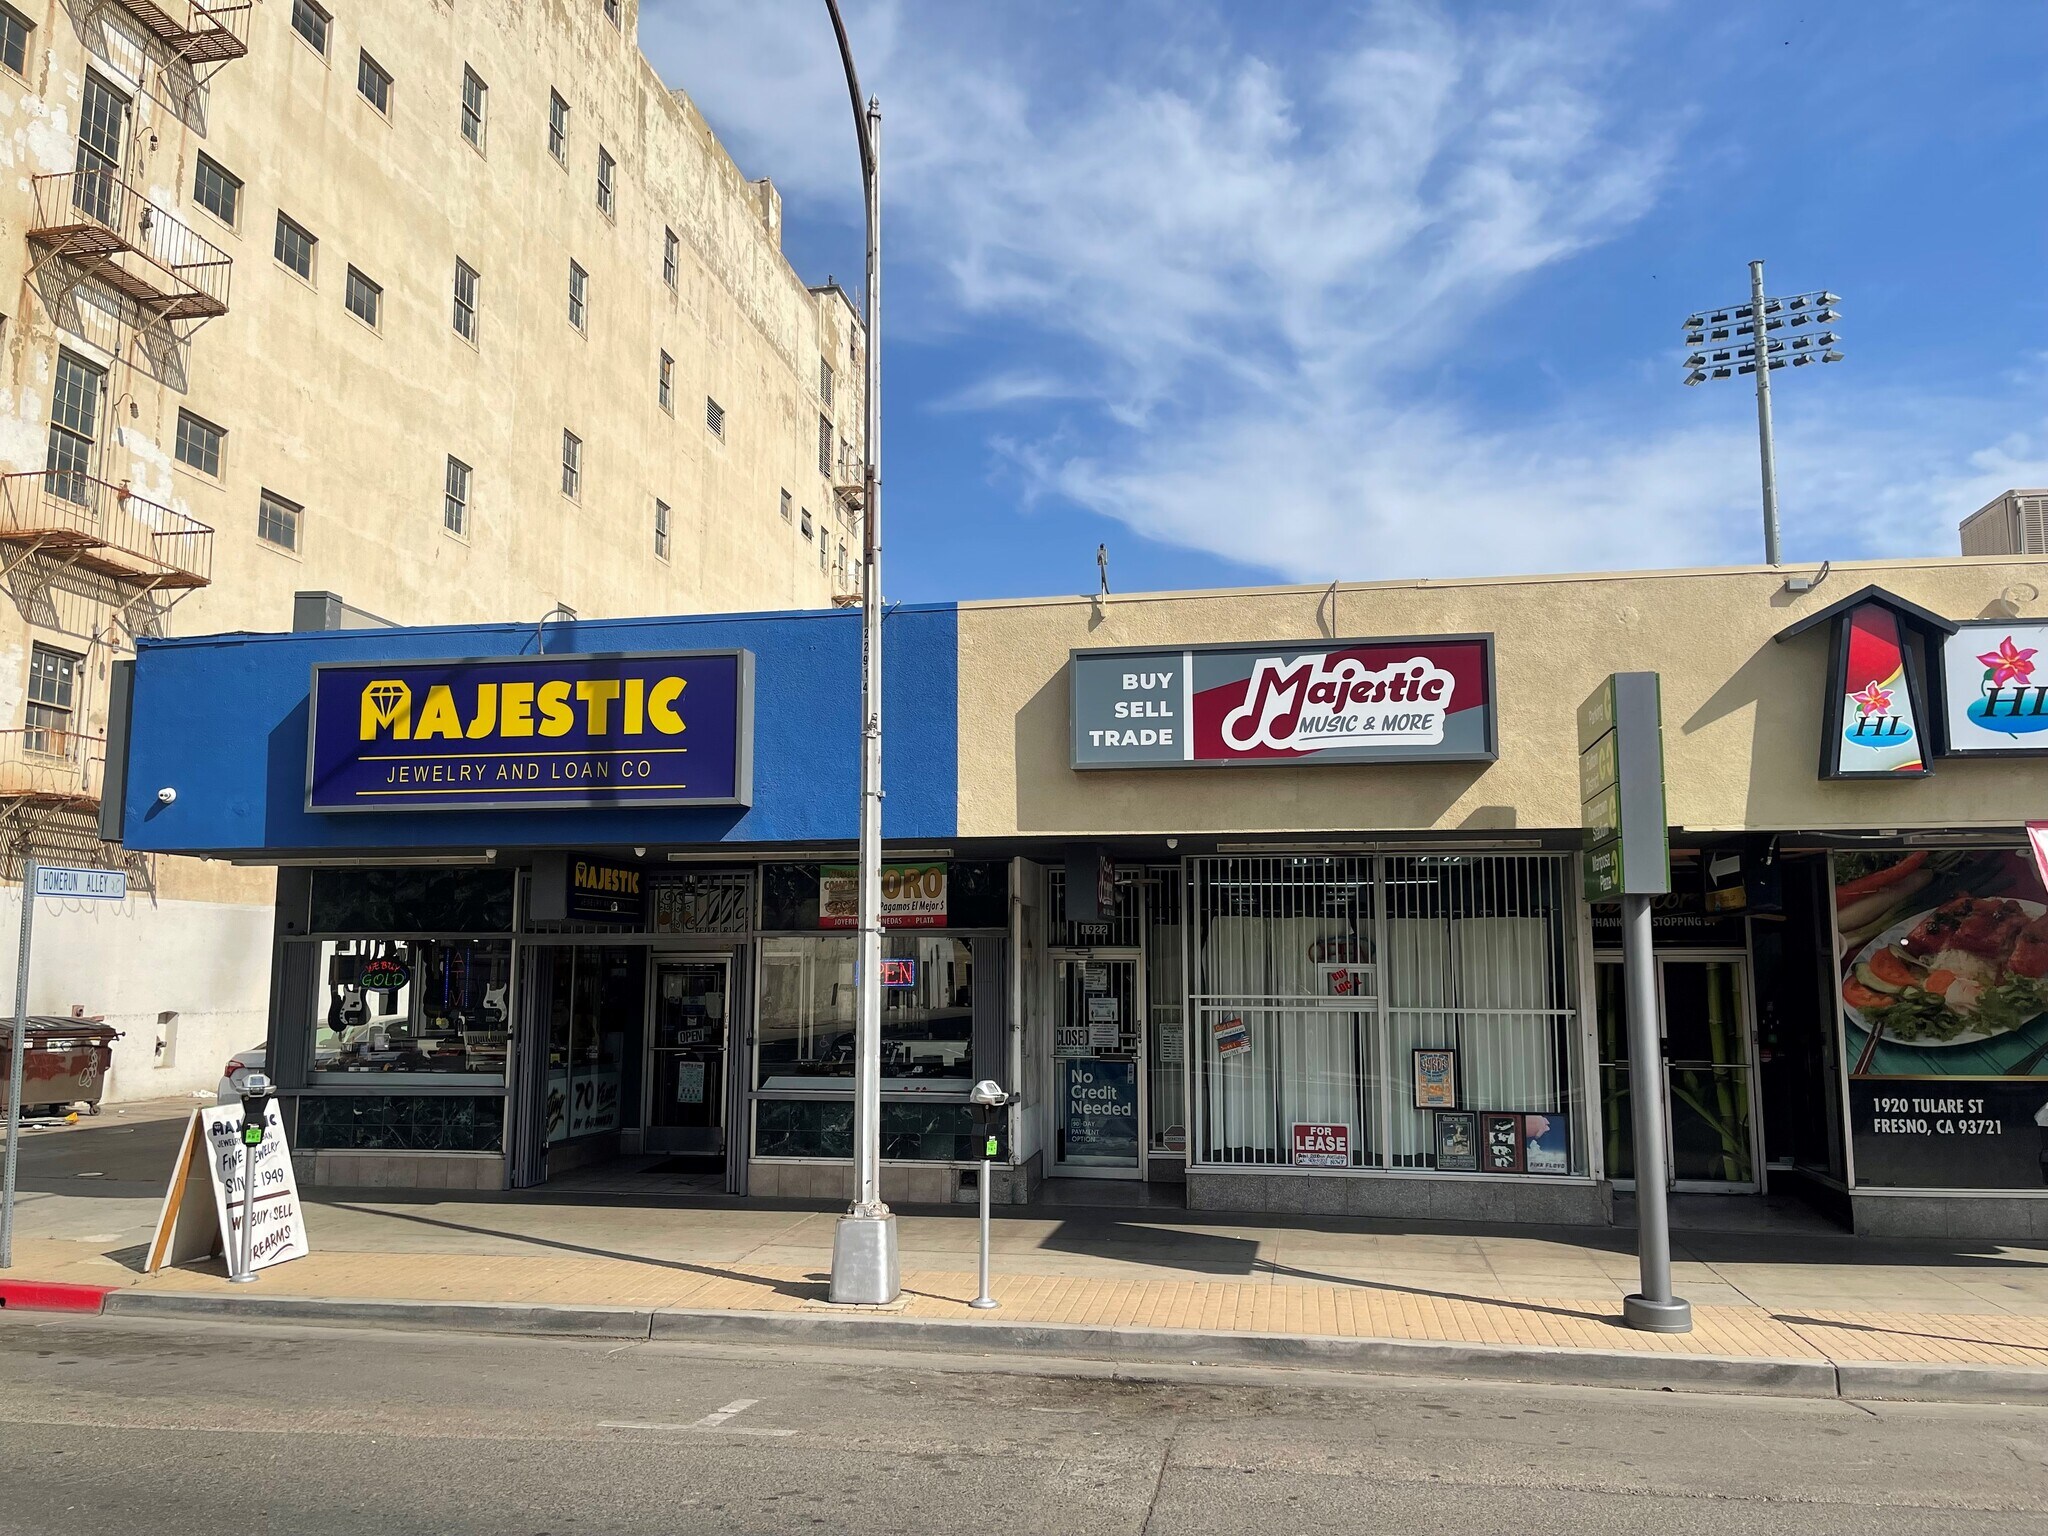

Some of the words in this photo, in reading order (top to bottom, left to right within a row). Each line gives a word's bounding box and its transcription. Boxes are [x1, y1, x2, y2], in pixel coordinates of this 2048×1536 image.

[1122, 672, 1173, 690] BUY
[359, 676, 688, 741] MAJESTIC
[1114, 701, 1173, 719] SELL
[1231, 663, 1443, 742] Majestic
[1299, 715, 1358, 733] MUSIC
[1362, 716, 1375, 731] &
[1381, 713, 1435, 731] MORE
[1853, 715, 1910, 737] HL
[1089, 729, 1173, 747] TRADE
[386, 764, 487, 783] JEWELRY
[496, 763, 540, 781] AND
[552, 761, 609, 780] LOAN
[621, 759, 652, 778] CO
[43, 871, 78, 891] HOMERUN
[87, 874, 108, 893] ALLEY
[575, 861, 640, 894] MAJESTIC
[881, 867, 943, 899] ORO
[911, 901, 919, 911] El
[919, 901, 938, 912] Mejor
[915, 916, 935, 924] PLATA
[1653, 917, 1701, 927] STOPPING
[1083, 925, 1107, 934] 1922
[362, 973, 405, 987] GOLD
[1331, 968, 1348, 981] BUY
[680, 1030, 702, 1043] OPEN
[1071, 1069, 1094, 1083] No
[575, 1080, 594, 1112] 70
[1071, 1084, 1117, 1100] Credit
[1071, 1100, 1131, 1116] Needed
[1873, 1097, 1908, 1113] 1920
[1912, 1098, 1964, 1114] TULARE
[1968, 1099, 1984, 1114] ST
[1310, 1126, 1332, 1136] FOR
[1873, 1119, 1932, 1136] FRESNO,
[1935, 1119, 1955, 1134] CA
[1958, 1119, 2002, 1135] 93721
[1296, 1135, 1346, 1152] LEASE
[222, 1150, 243, 1172] FINE
[255, 1141, 281, 1164] EWELRY
[261, 1168, 284, 1187] 1949
[273, 1203, 293, 1220] SELL
